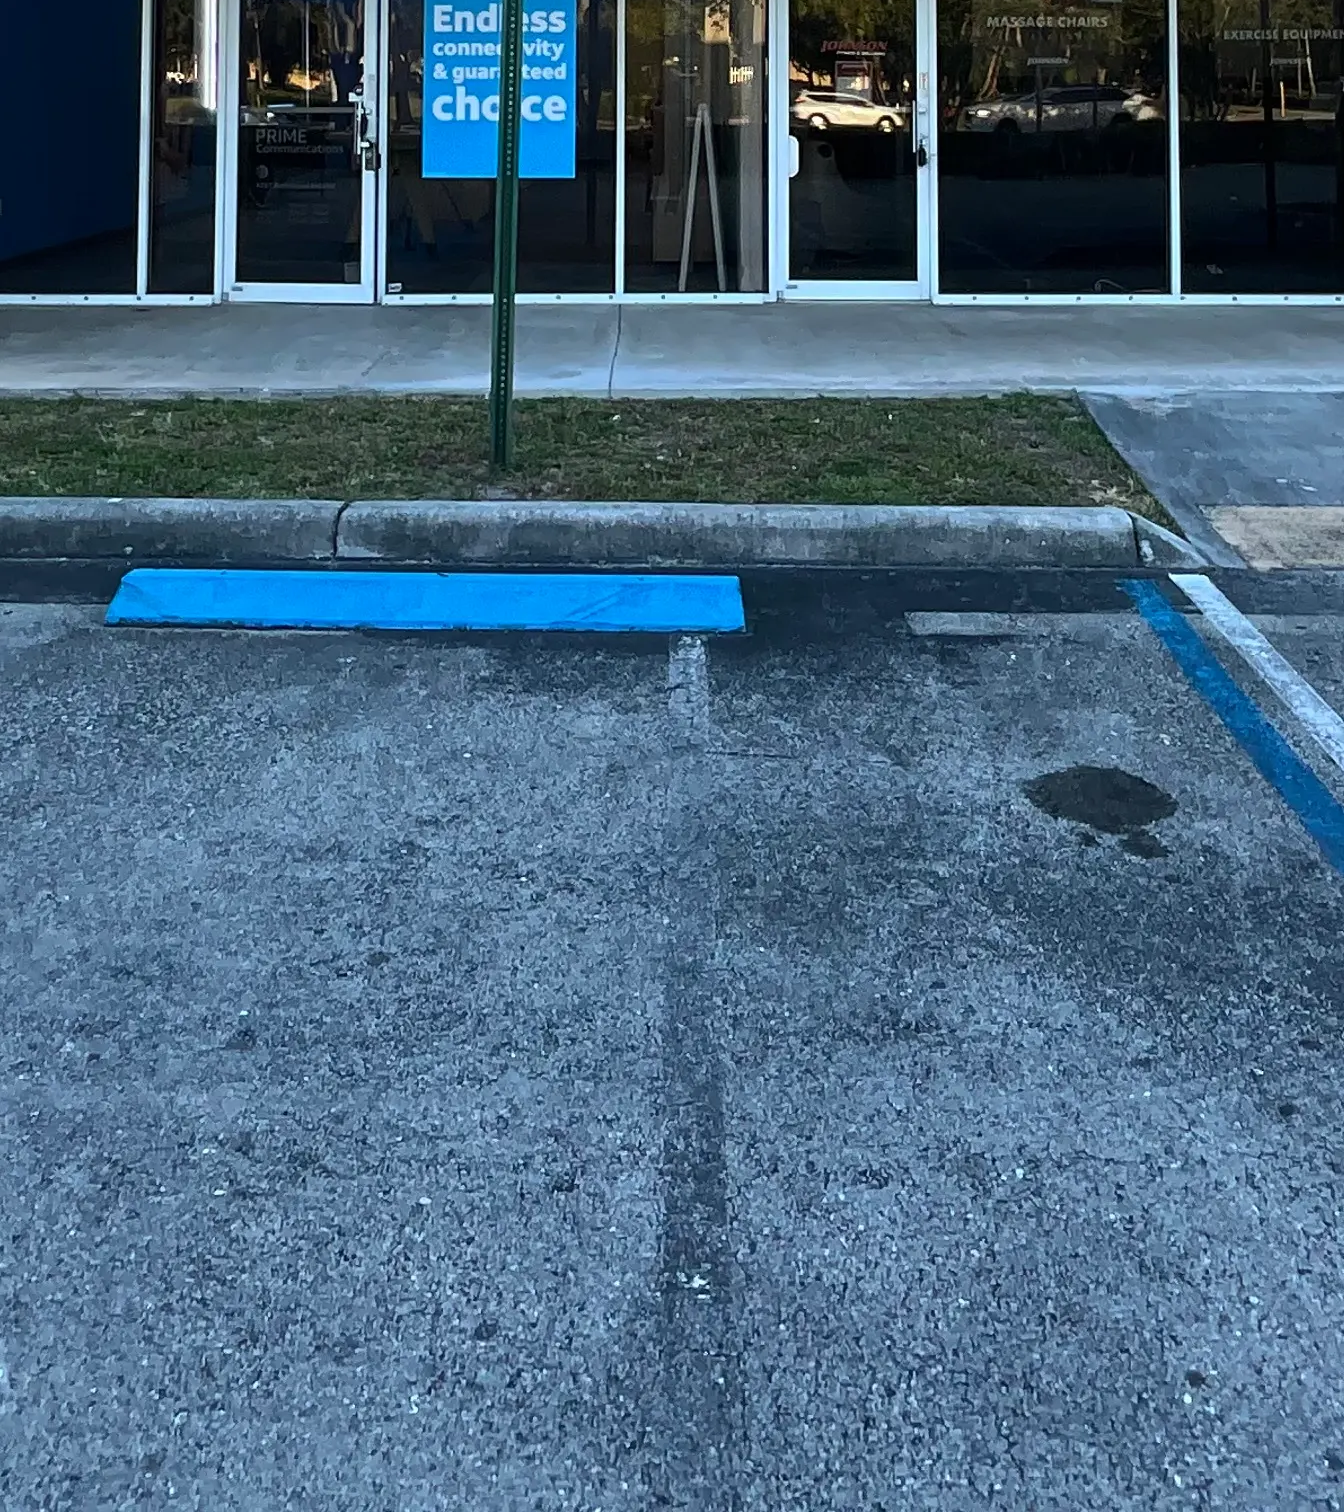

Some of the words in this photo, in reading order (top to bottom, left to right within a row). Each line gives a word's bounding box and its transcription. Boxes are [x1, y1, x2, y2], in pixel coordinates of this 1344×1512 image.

[986, 16, 1053, 28] MASSAGE
[1057, 16, 1108, 28] CHAIRS
[1223, 29, 1278, 40] EXERCISE
[432, 38, 565, 61] connevity
[432, 63, 448, 80] &
[451, 62, 568, 84] guarteed
[432, 86, 568, 121] choce
[256, 129, 308, 144] PRIME
